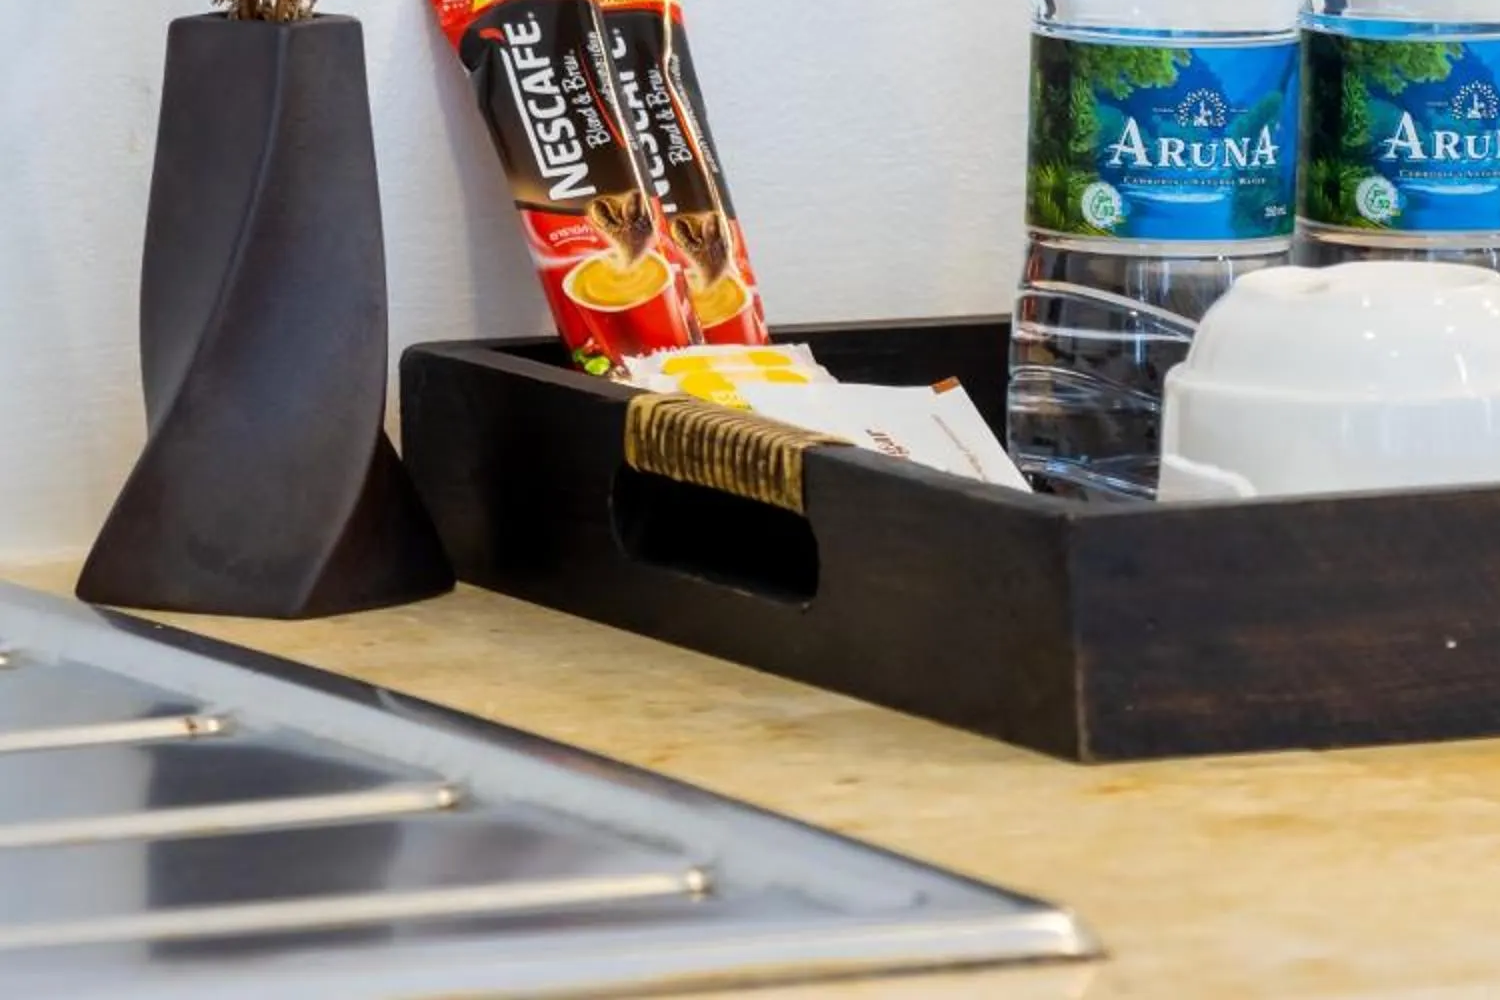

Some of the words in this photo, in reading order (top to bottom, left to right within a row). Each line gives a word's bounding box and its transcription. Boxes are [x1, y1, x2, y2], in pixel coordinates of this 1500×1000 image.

[573, 90, 592, 106] &
[656, 108, 675, 124] &
[577, 106, 611, 149] Blend
[660, 124, 693, 167] Blend
[1107, 115, 1280, 168] ARUNA
